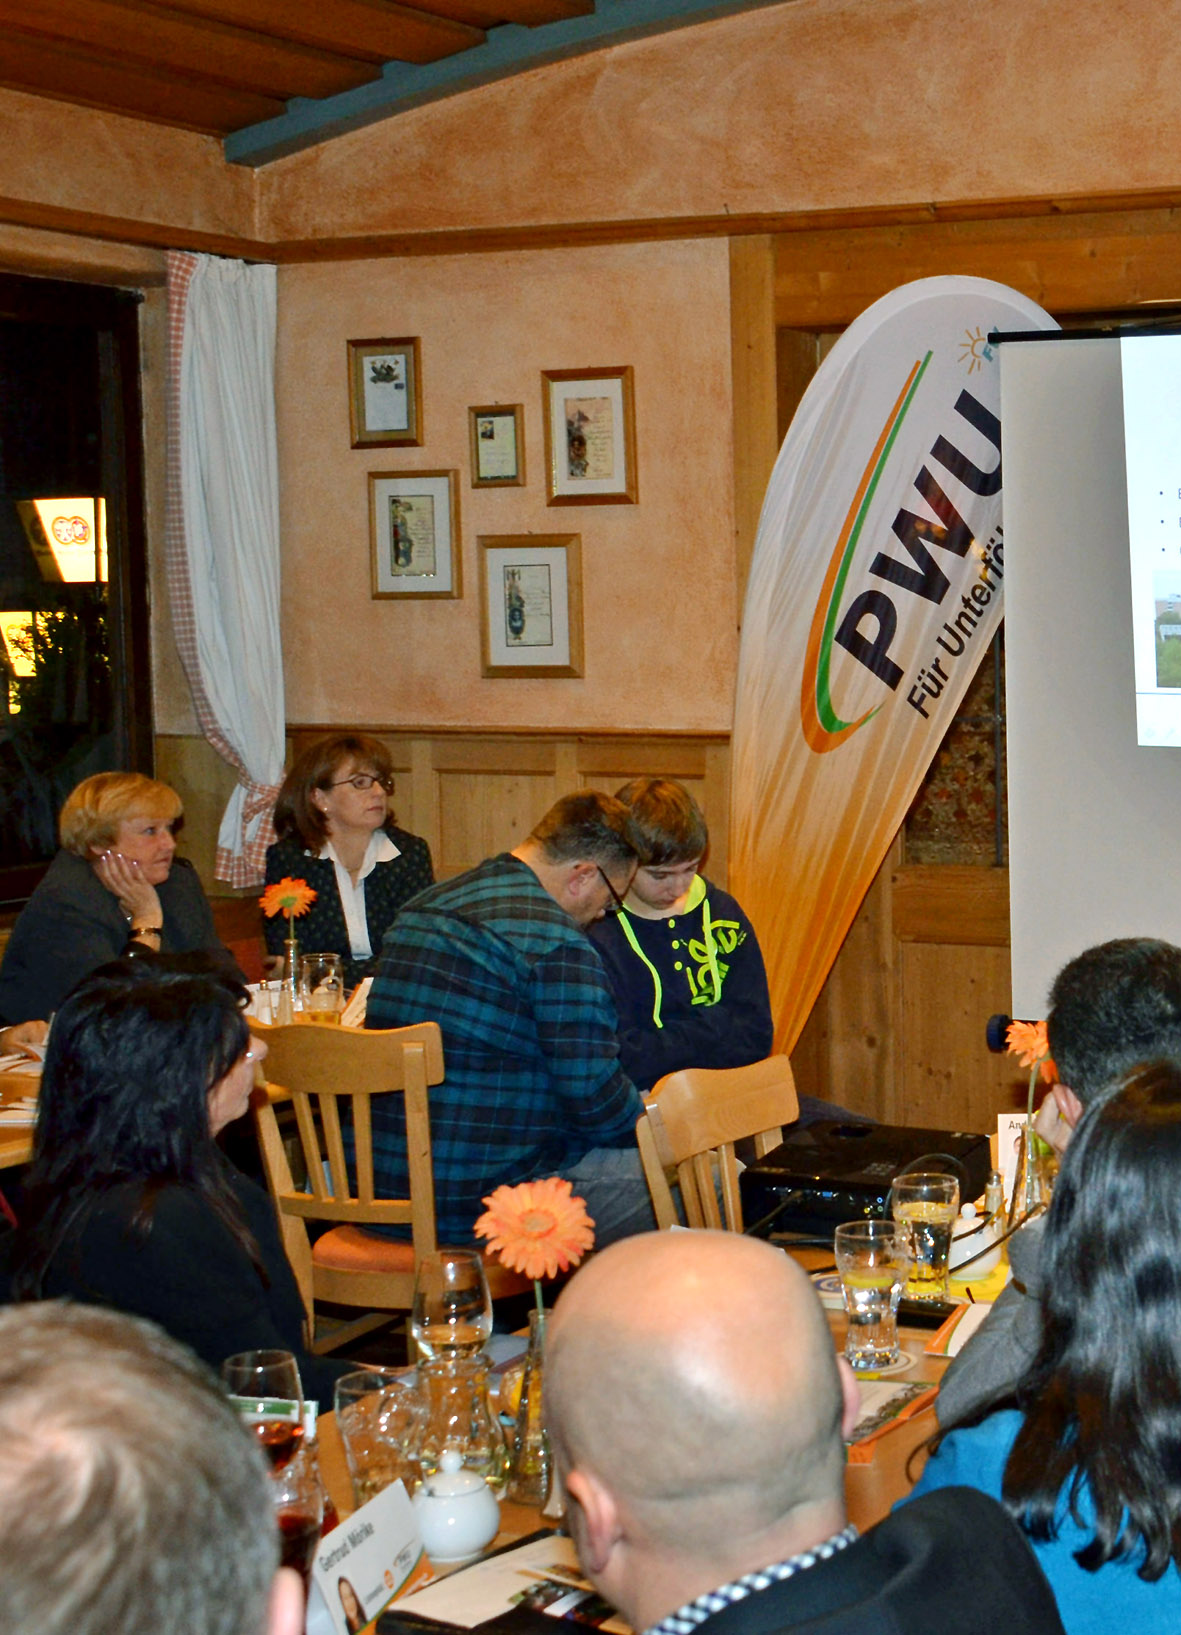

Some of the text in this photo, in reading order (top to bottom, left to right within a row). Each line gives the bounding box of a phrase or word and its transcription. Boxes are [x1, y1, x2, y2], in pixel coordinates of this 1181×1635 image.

[835, 388, 1003, 692] PWU
[906, 525, 1004, 719] Für Unterfö
